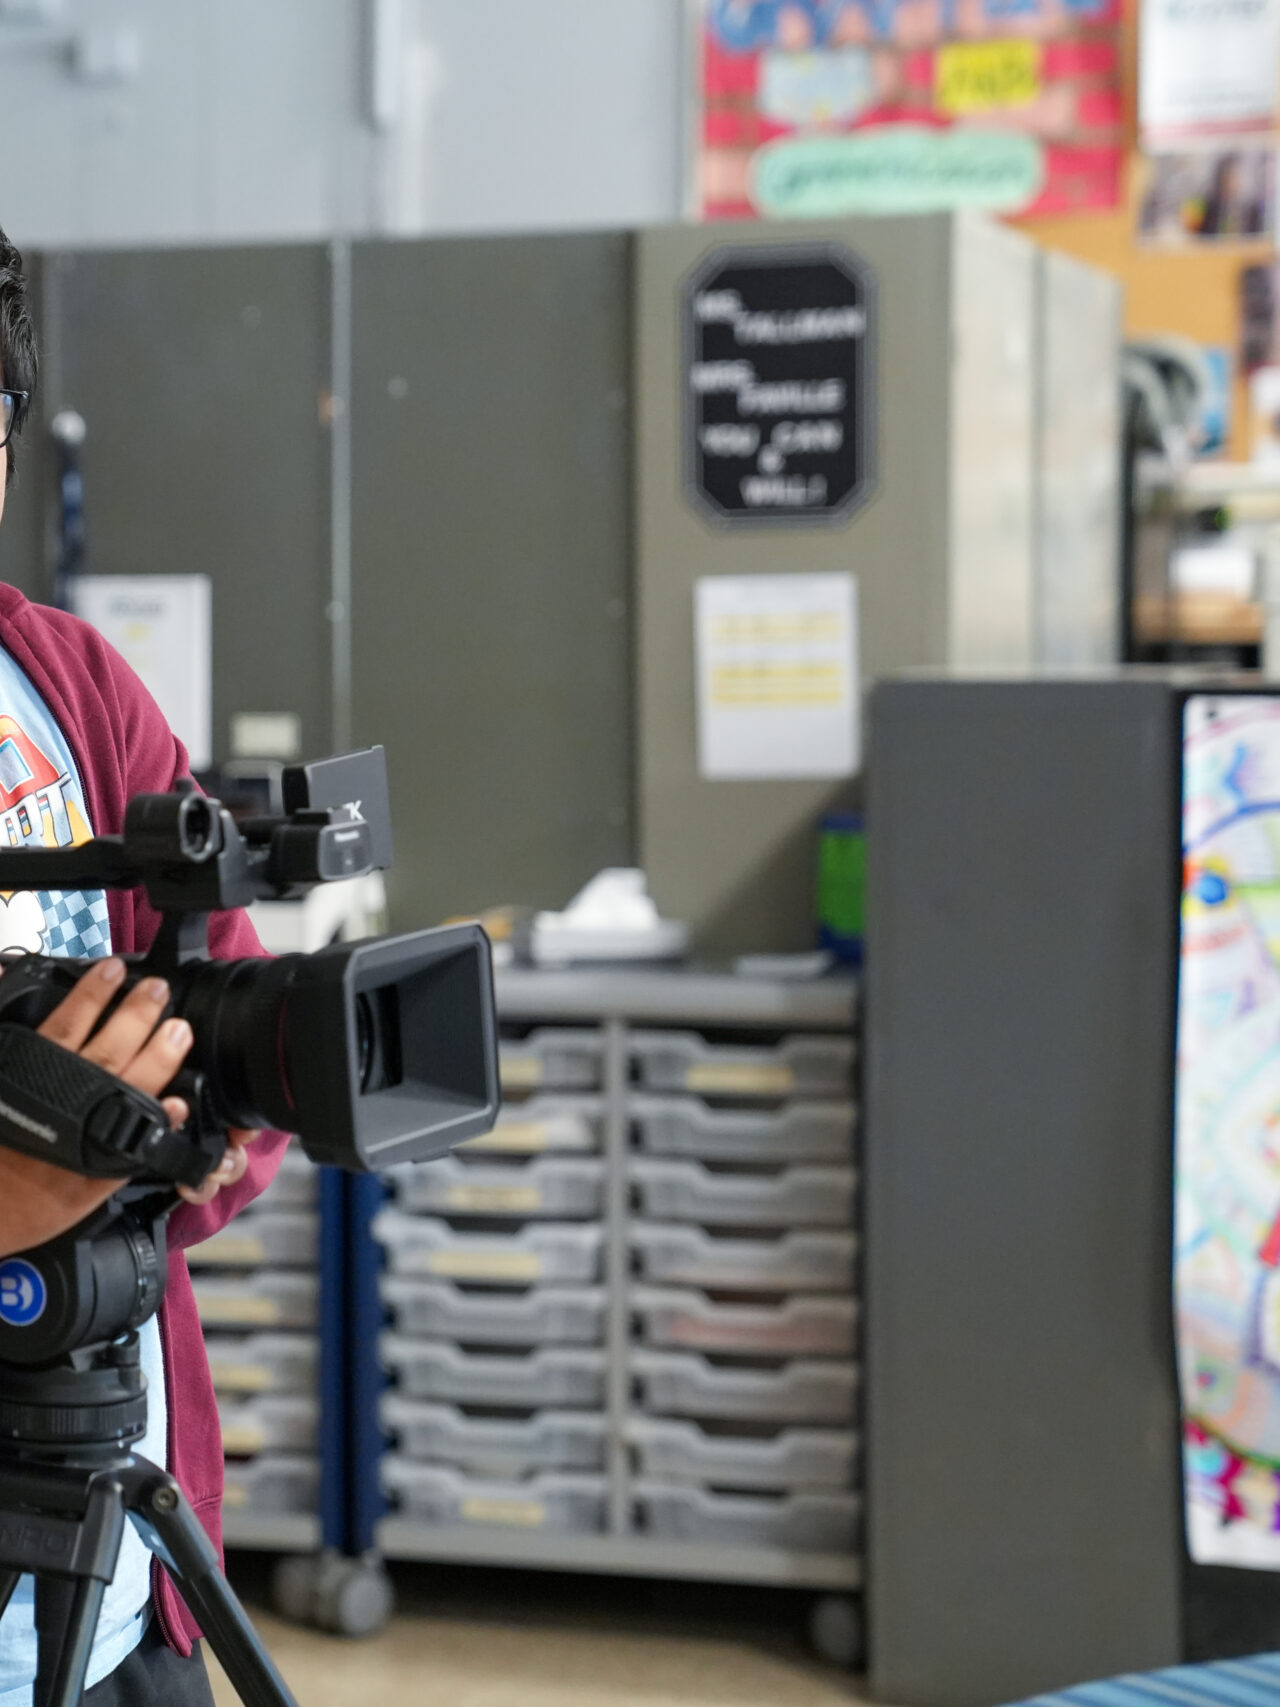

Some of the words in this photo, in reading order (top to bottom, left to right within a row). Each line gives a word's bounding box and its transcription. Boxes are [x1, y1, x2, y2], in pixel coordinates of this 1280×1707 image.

[734, 308, 863, 341] TALLMAN
[701, 426, 757, 455] YOU
[774, 423, 840, 451] CAN
